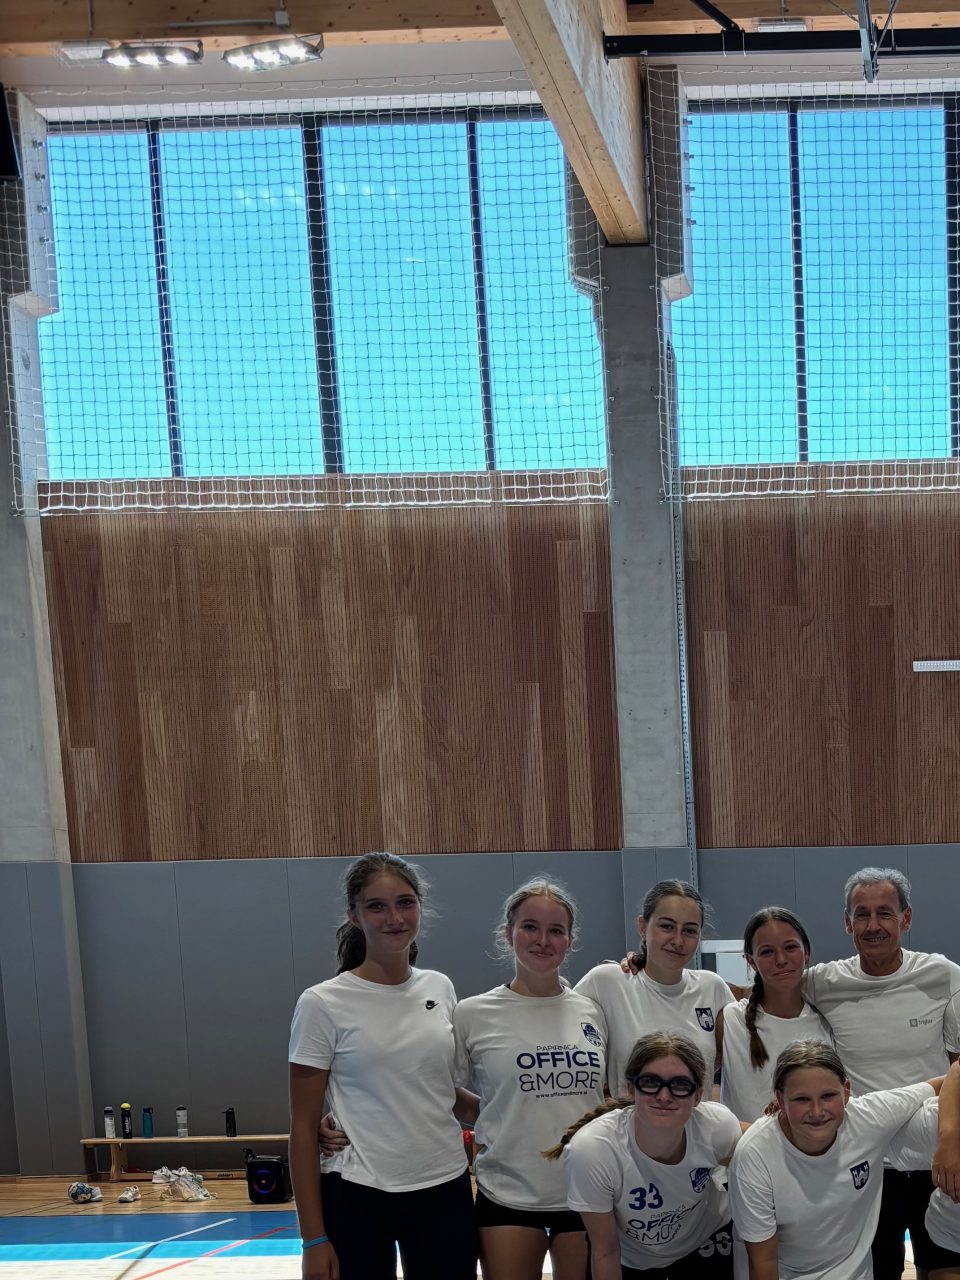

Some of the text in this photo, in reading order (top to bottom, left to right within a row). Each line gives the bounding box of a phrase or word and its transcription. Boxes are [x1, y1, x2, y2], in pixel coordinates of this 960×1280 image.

[516, 1051, 600, 1070] OFFICE
[519, 1071, 600, 1092] &MORE
[628, 1182, 664, 1211] 33
